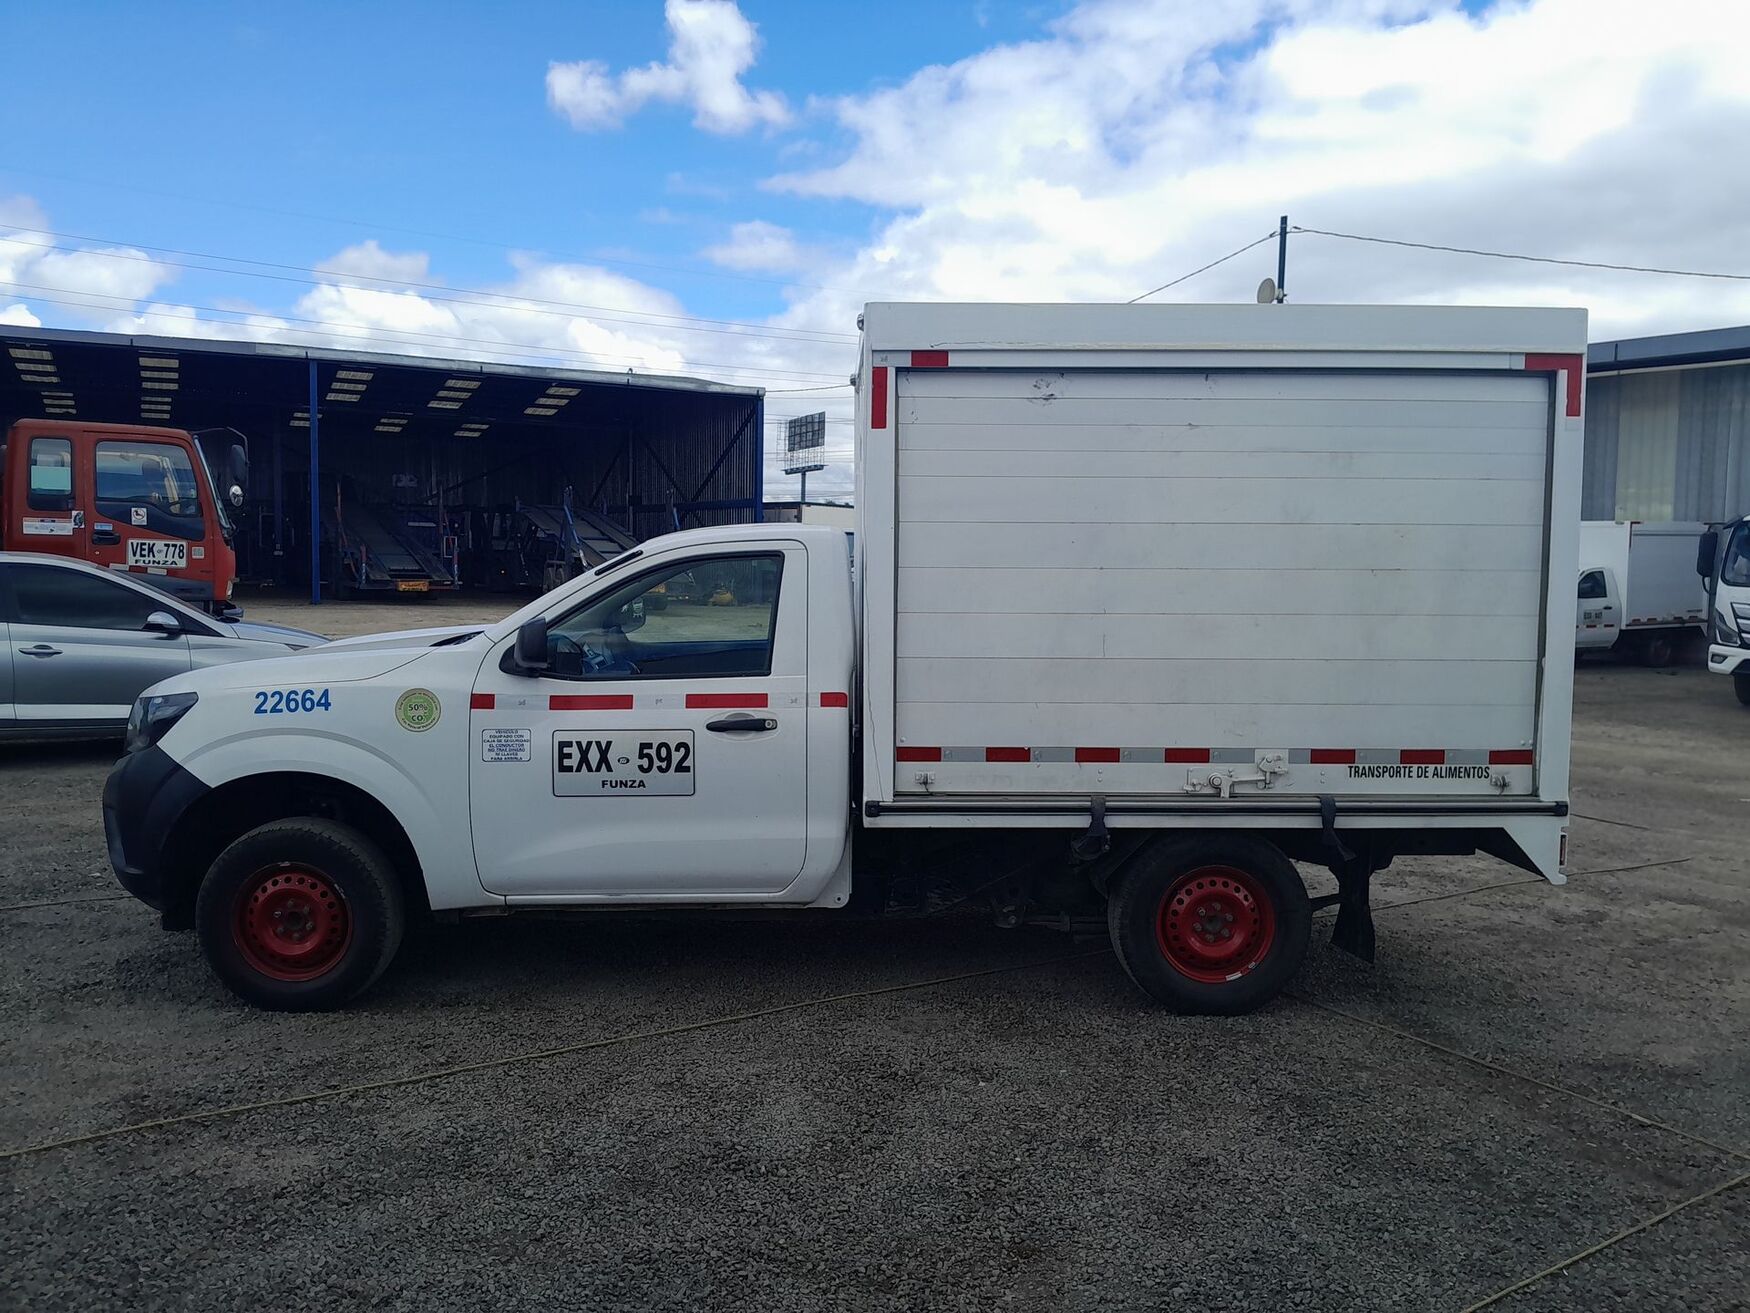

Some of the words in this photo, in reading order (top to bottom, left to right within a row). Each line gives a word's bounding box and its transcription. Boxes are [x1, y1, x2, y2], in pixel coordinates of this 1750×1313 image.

[130, 542, 155, 558] VEK
[163, 543, 185, 559] 778
[254, 688, 332, 715] 22664
[408, 703, 428, 711] 50%
[557, 740, 613, 773] EXX
[637, 741, 691, 774] 592
[1347, 765, 1414, 778] TRANSPORTE
[1416, 765, 1429, 778] DE
[1432, 766, 1490, 779] ALIMENTOS
[601, 779, 646, 789] FUNZA
